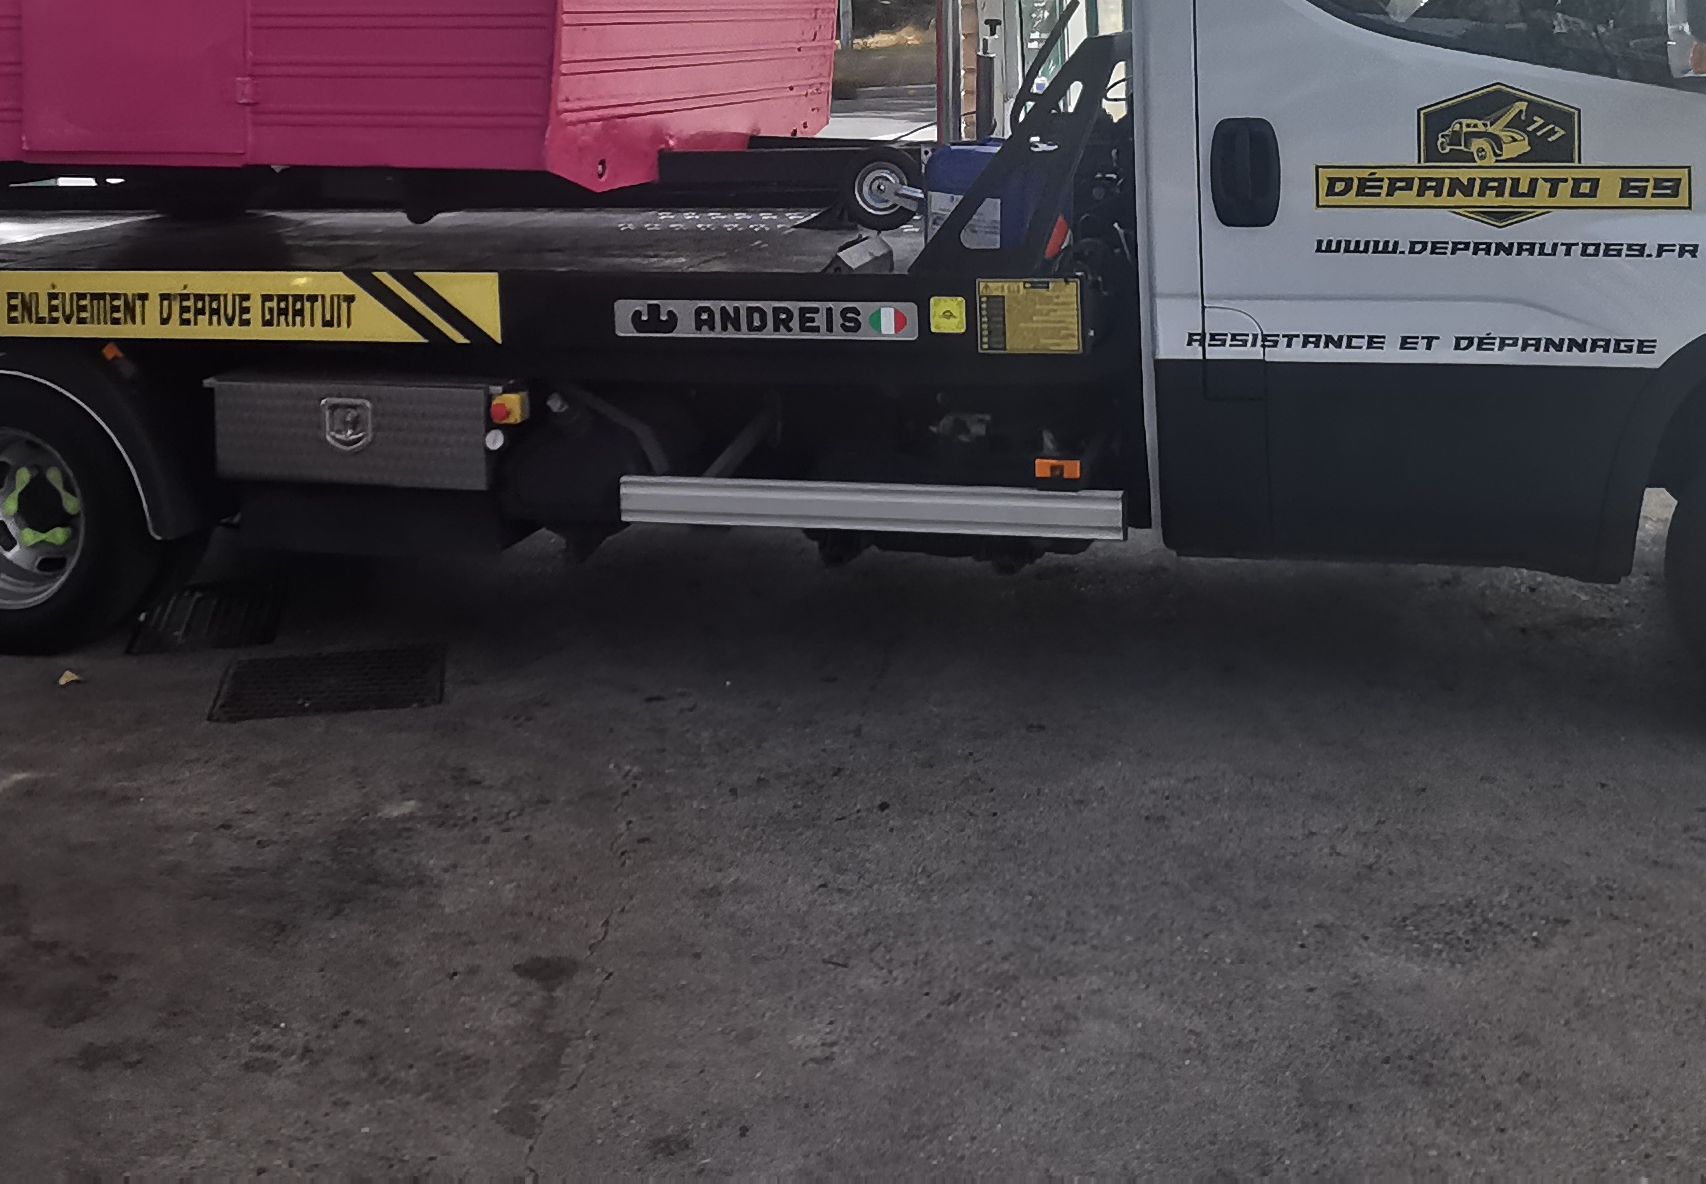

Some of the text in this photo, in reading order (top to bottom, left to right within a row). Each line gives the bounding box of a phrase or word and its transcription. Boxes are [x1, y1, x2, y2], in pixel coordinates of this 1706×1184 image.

[1526, 115, 1566, 142] 7/7
[1324, 172, 1682, 199] DÉPANAUTO 69
[1315, 238, 1700, 259] WWW.DEPANAUTO69.FR
[159, 284, 251, 327] D'ÉPAVE
[260, 293, 356, 328] GRATUIT
[694, 304, 862, 334] ANDREIS
[1186, 331, 1658, 356] ASSISTANCE ET DÉPANNAGE
